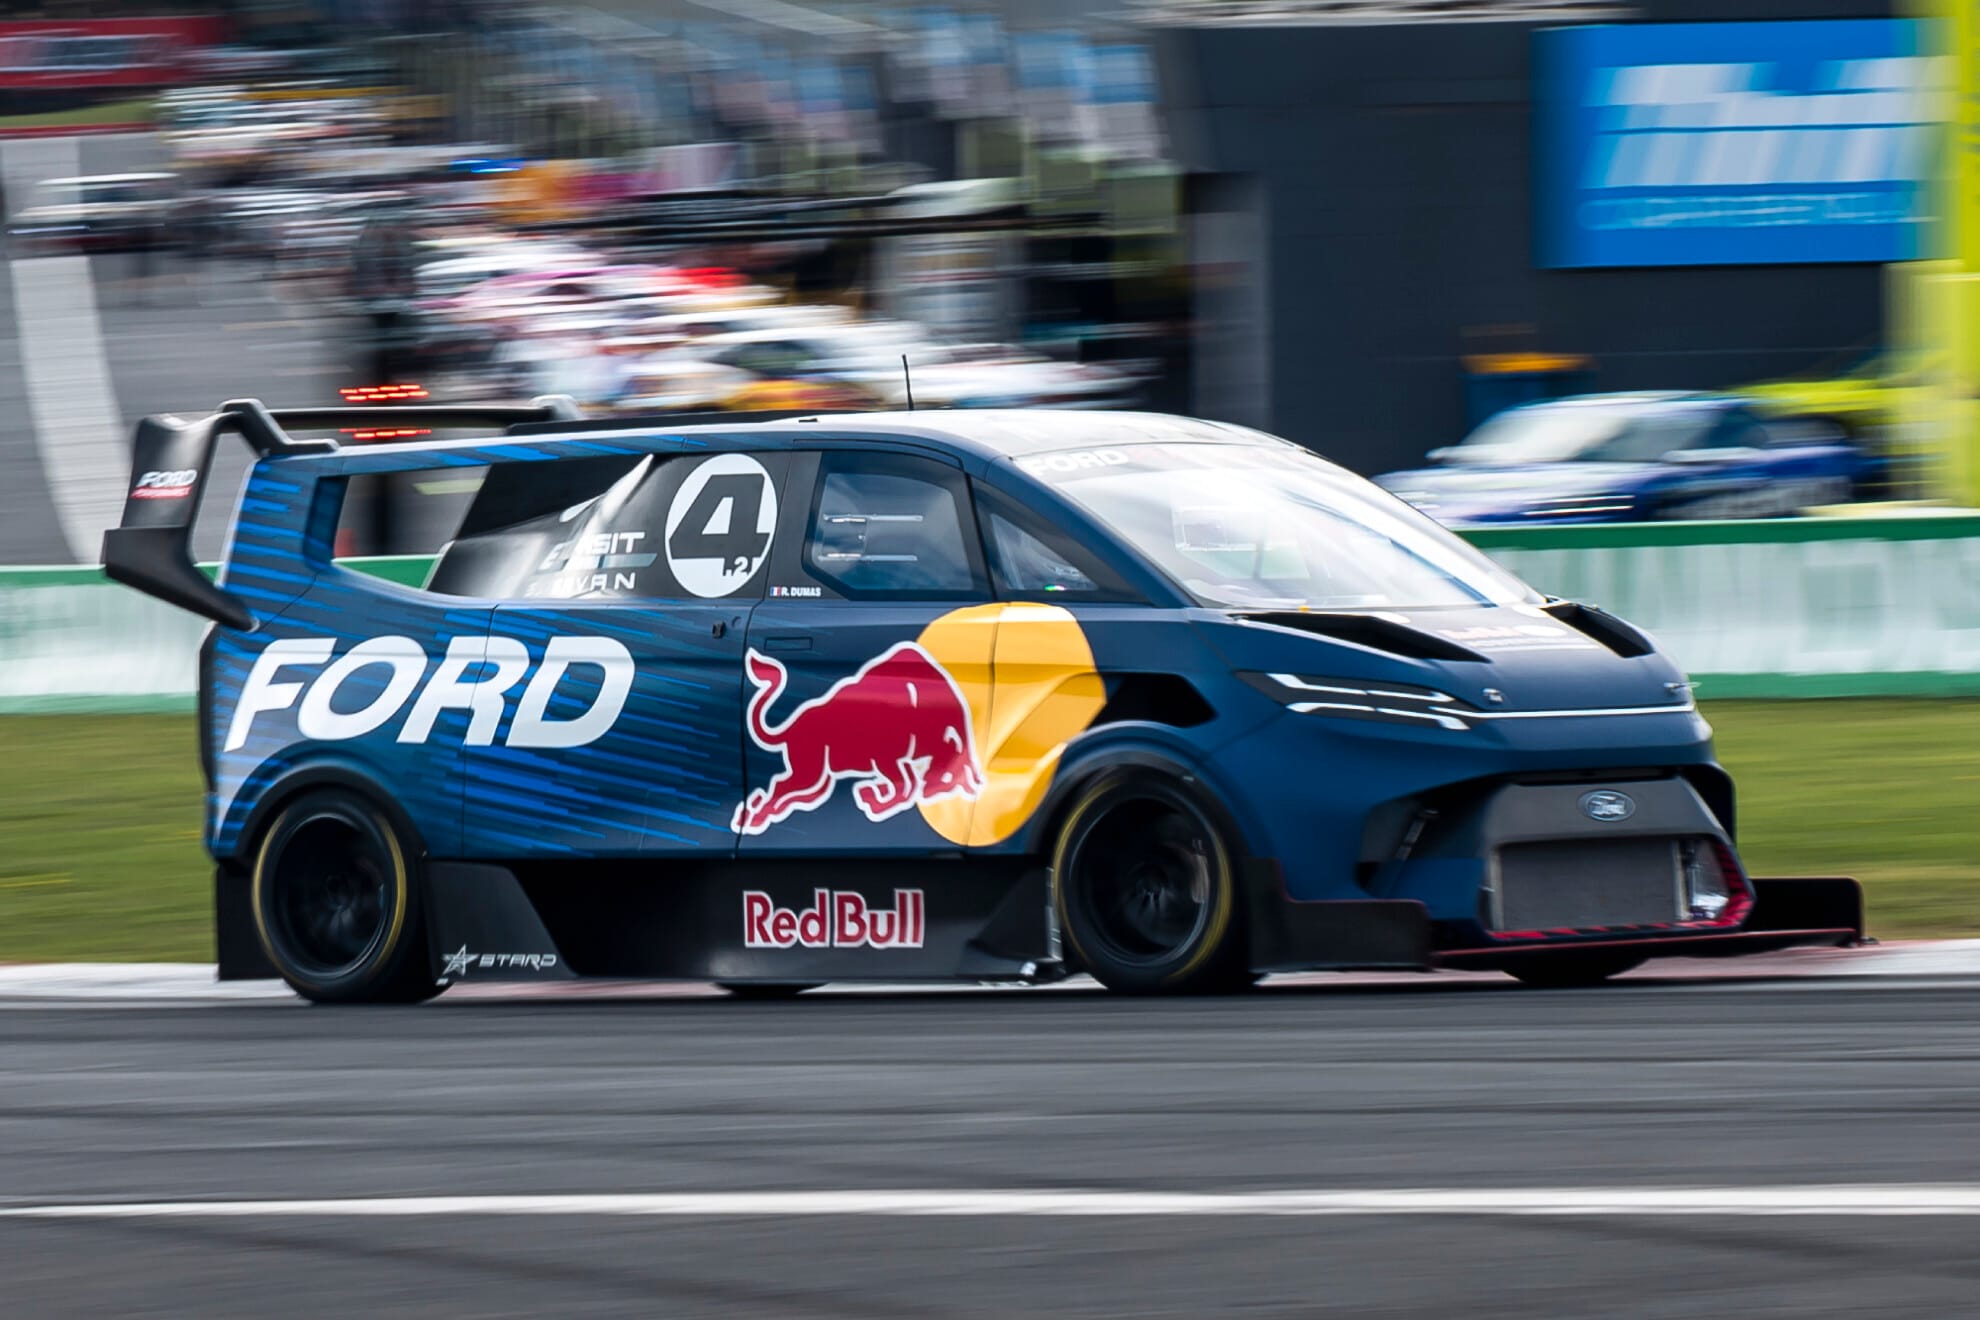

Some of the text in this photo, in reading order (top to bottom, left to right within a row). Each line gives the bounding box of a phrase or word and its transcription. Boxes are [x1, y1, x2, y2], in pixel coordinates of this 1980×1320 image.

[1024, 449, 1129, 476] FORD
[135, 469, 198, 488] FORD
[790, 586, 822, 597] DUMAS
[223, 635, 636, 752] FORD
[743, 888, 925, 949] Red Bull
[478, 953, 558, 971] STARD
